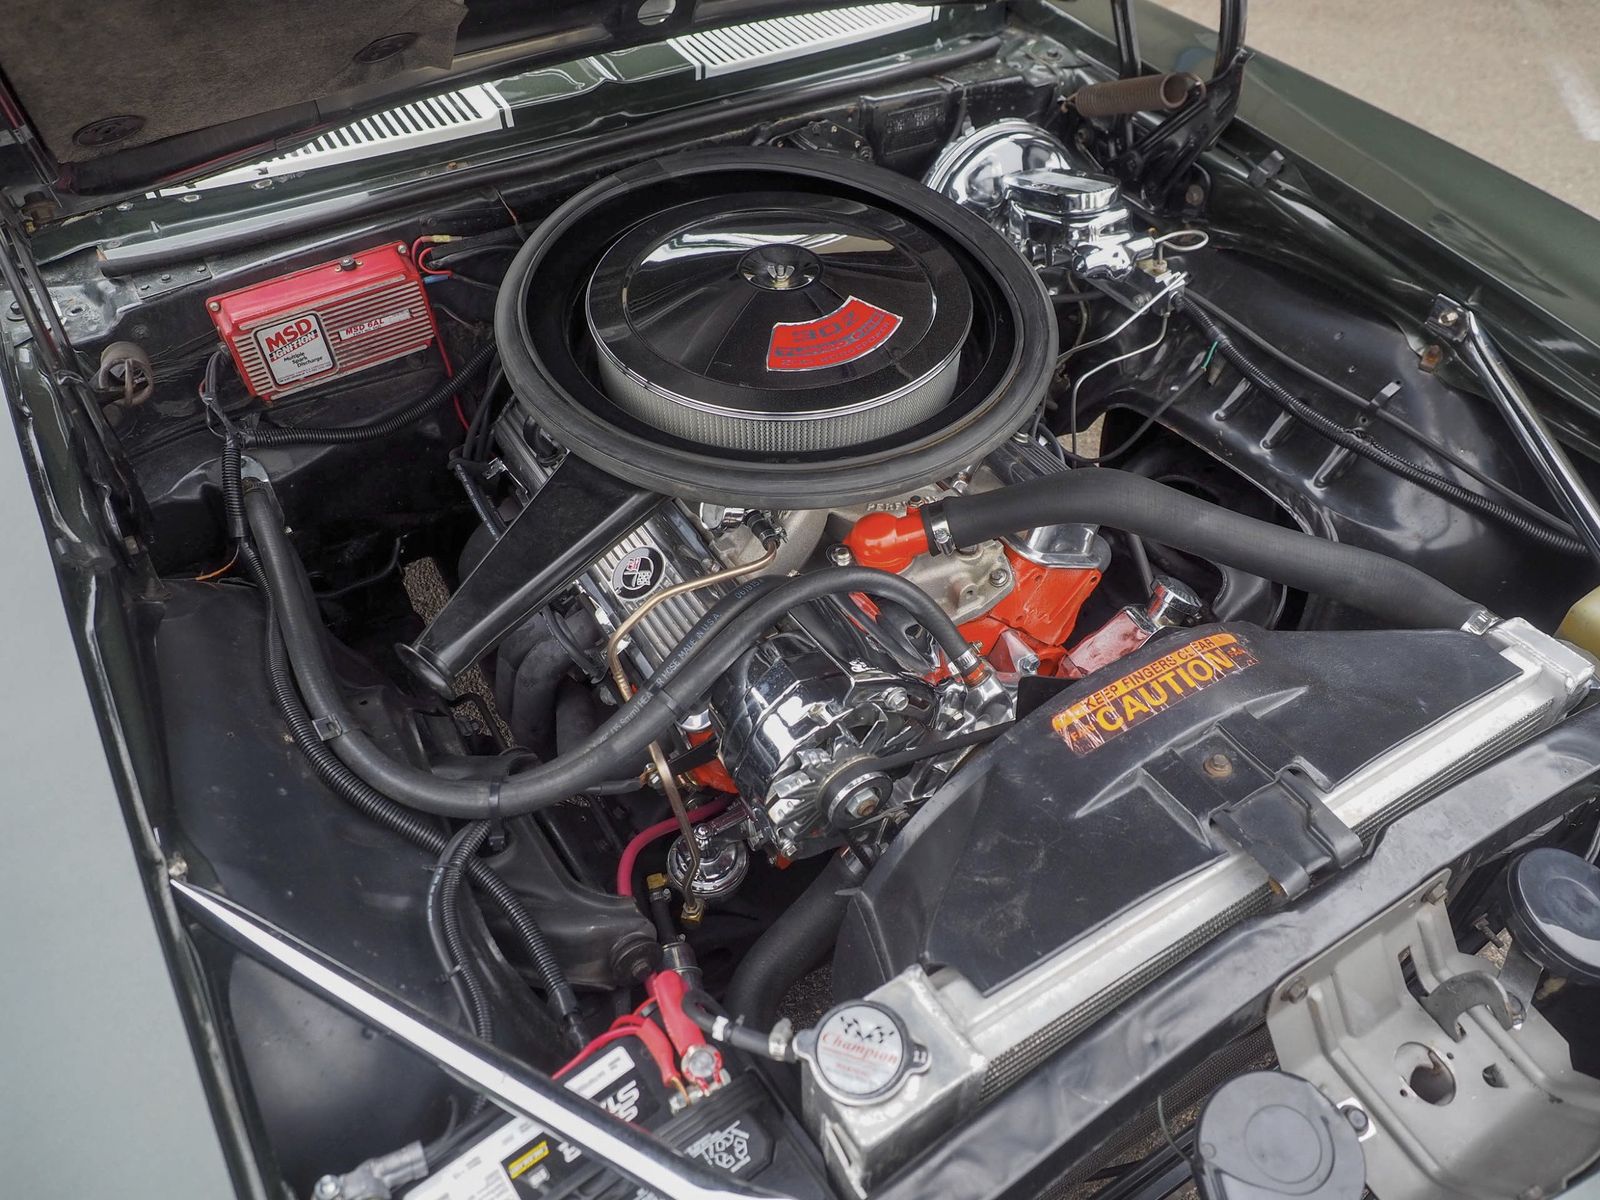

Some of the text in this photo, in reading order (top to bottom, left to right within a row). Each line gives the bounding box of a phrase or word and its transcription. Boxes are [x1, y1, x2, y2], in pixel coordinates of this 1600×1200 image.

[265, 318, 312, 353] MSD
[345, 324, 365, 336] MSD
[271, 330, 316, 361] IGNITION
[283, 352, 305, 362] Multiple
[292, 356, 308, 365] Spark
[297, 356, 323, 368] Discharge
[1085, 684, 1118, 709] KEEP
[1122, 655, 1178, 690] FINGERS
[1097, 649, 1235, 732] CAUTION
